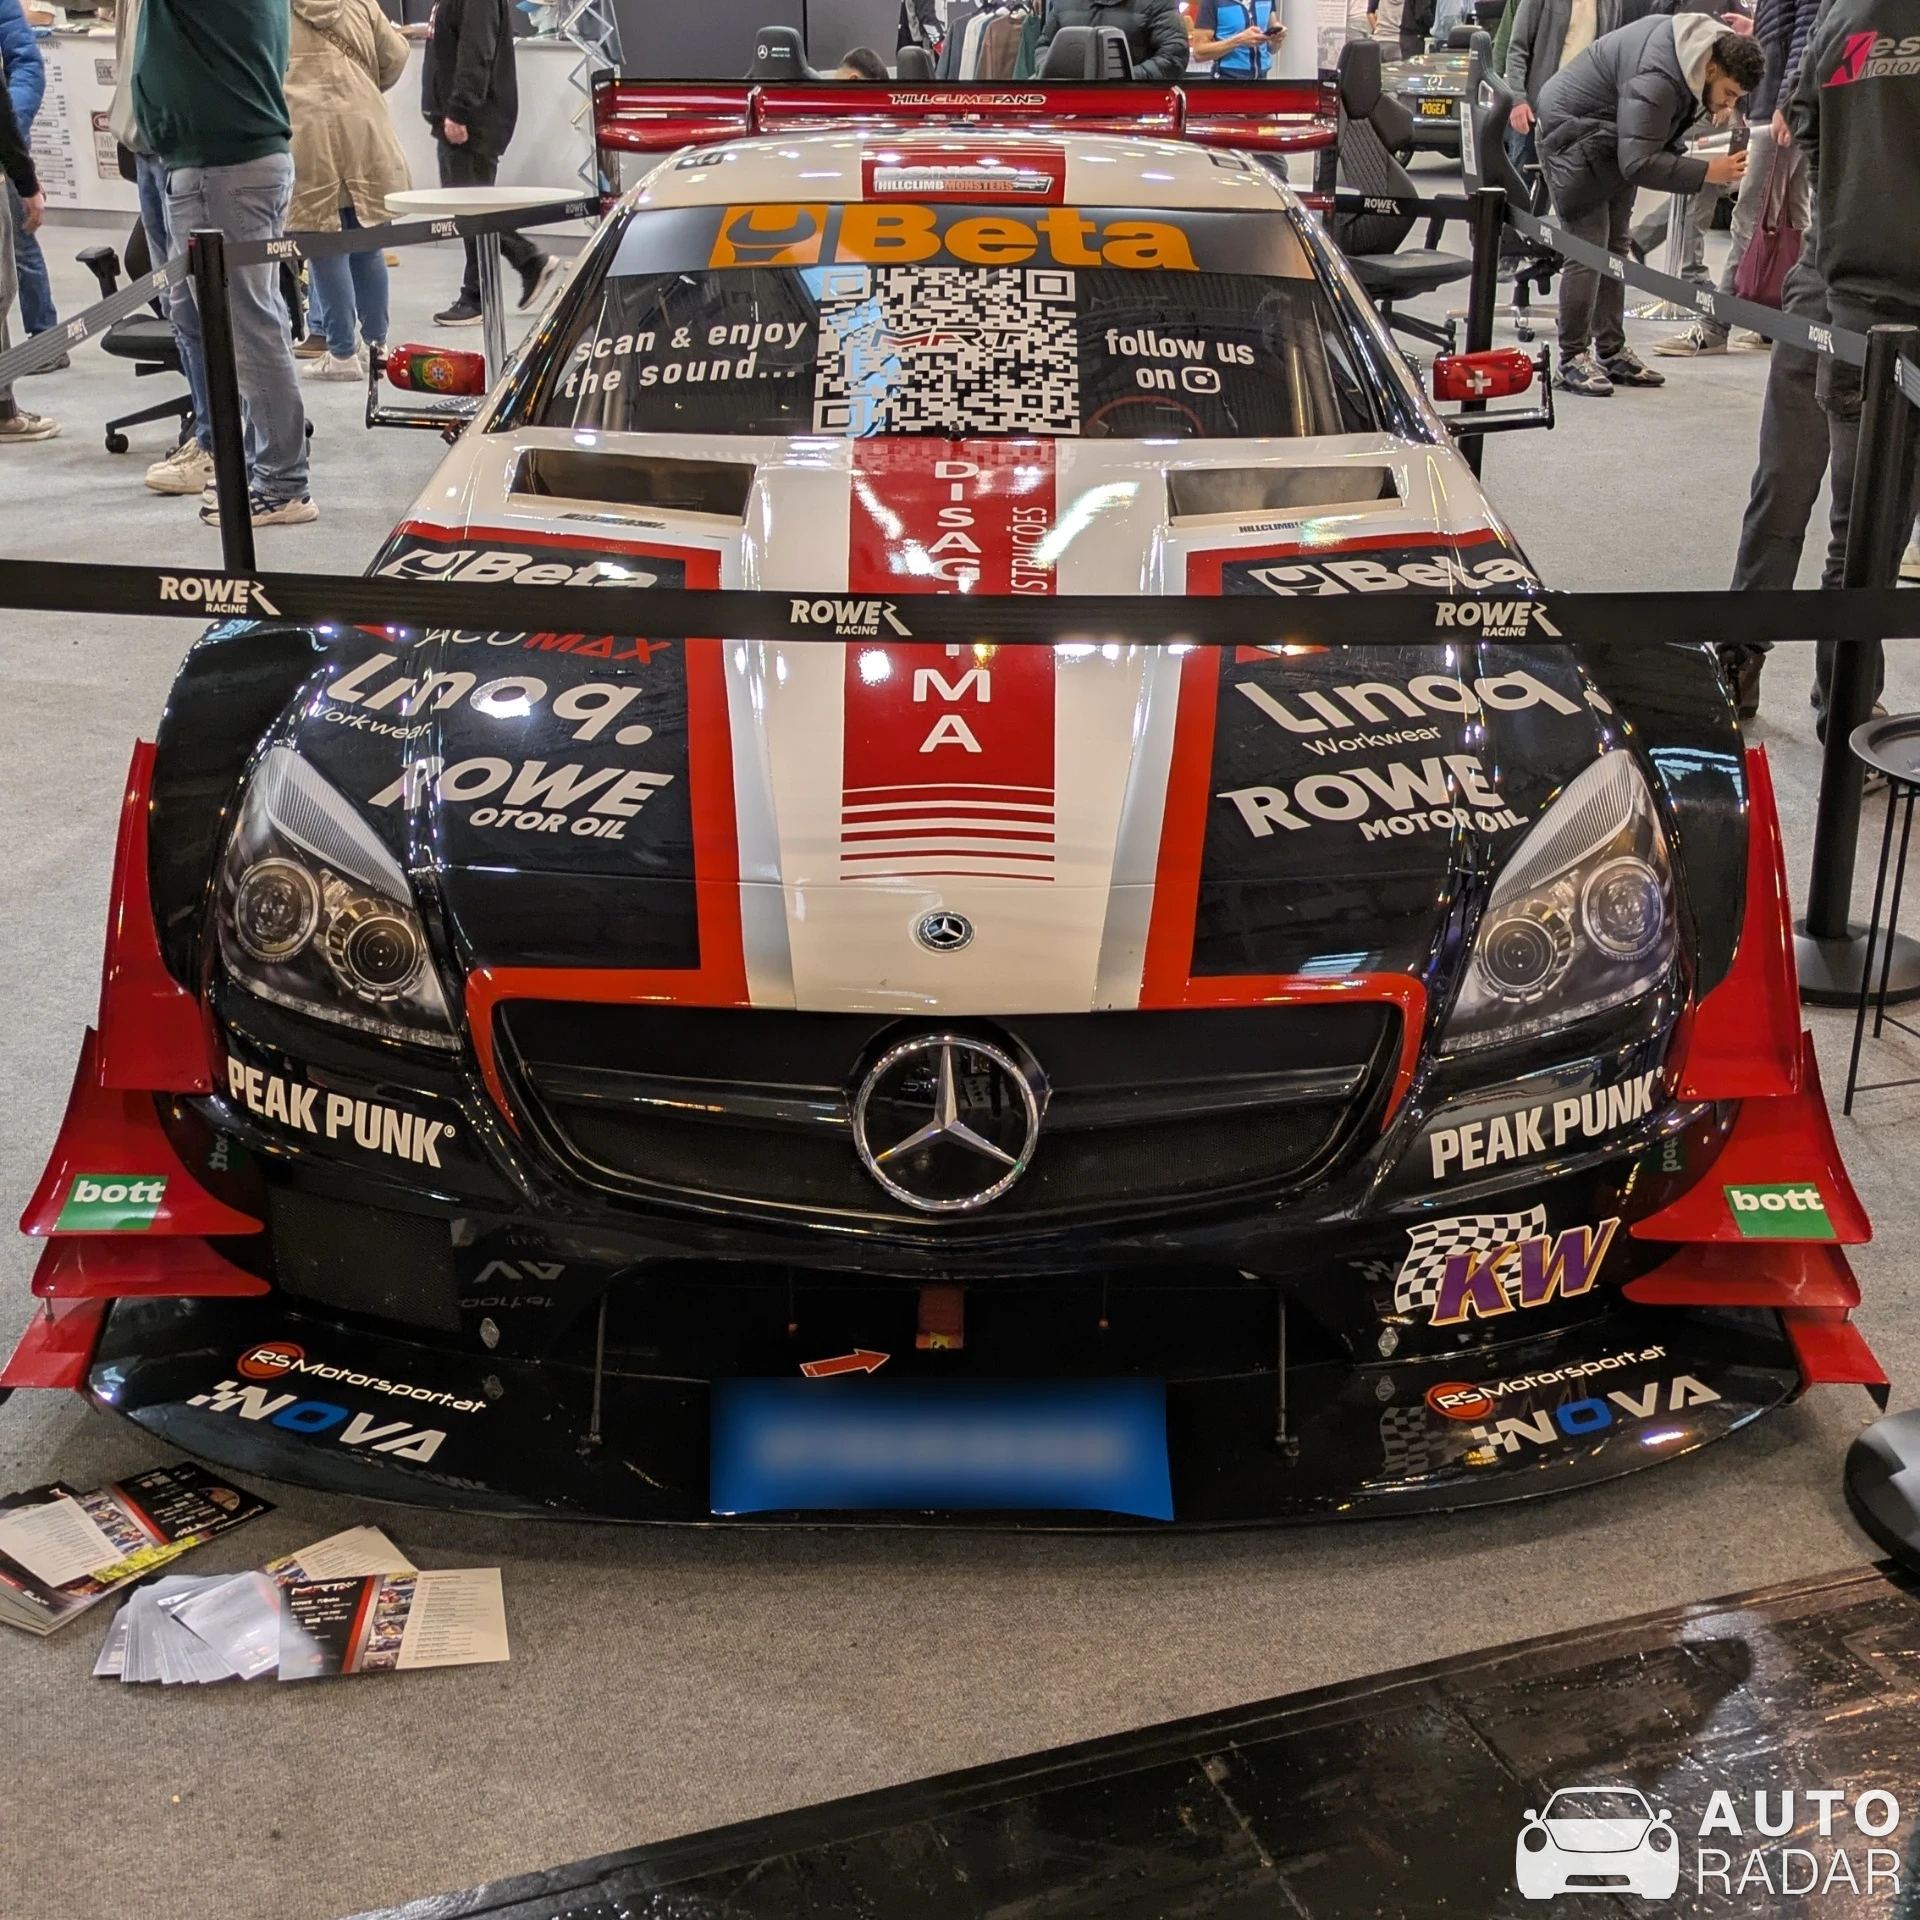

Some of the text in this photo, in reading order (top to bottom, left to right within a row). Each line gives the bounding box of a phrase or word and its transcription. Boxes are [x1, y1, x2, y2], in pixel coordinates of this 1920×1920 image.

[1421, 103, 1446, 115] POGEA
[1364, 197, 1393, 210] ROWE
[431, 221, 453, 234] ROWE
[834, 204, 1200, 272] Beta
[267, 240, 293, 255] ROWE
[574, 320, 808, 362] scan & enjoy
[1104, 328, 1255, 365] follow us
[1808, 324, 1829, 345] ROWE
[564, 351, 796, 398] the sound...
[1135, 367, 1176, 390] on
[449, 550, 658, 588] Beta
[1322, 555, 1541, 593] Beta
[158, 576, 250, 603] ROWE
[205, 603, 248, 614] RACING
[790, 599, 882, 625] ROWE
[913, 460, 990, 752] DISAGMA
[1435, 601, 1532, 626] ROWE
[835, 625, 878, 635] RACING
[1481, 627, 1527, 637] RACING
[1302, 723, 1443, 757] Workwear
[1216, 753, 1506, 838] ROWE
[469, 807, 627, 840] OTOR OIL
[1358, 808, 1530, 842] MOTOR OIL
[228, 1055, 318, 1134] PEAK
[1430, 1105, 1546, 1180] PEAK
[73, 1180, 166, 1203] bott
[1730, 1188, 1825, 1211] bott
[1428, 1216, 1621, 1326] KW
